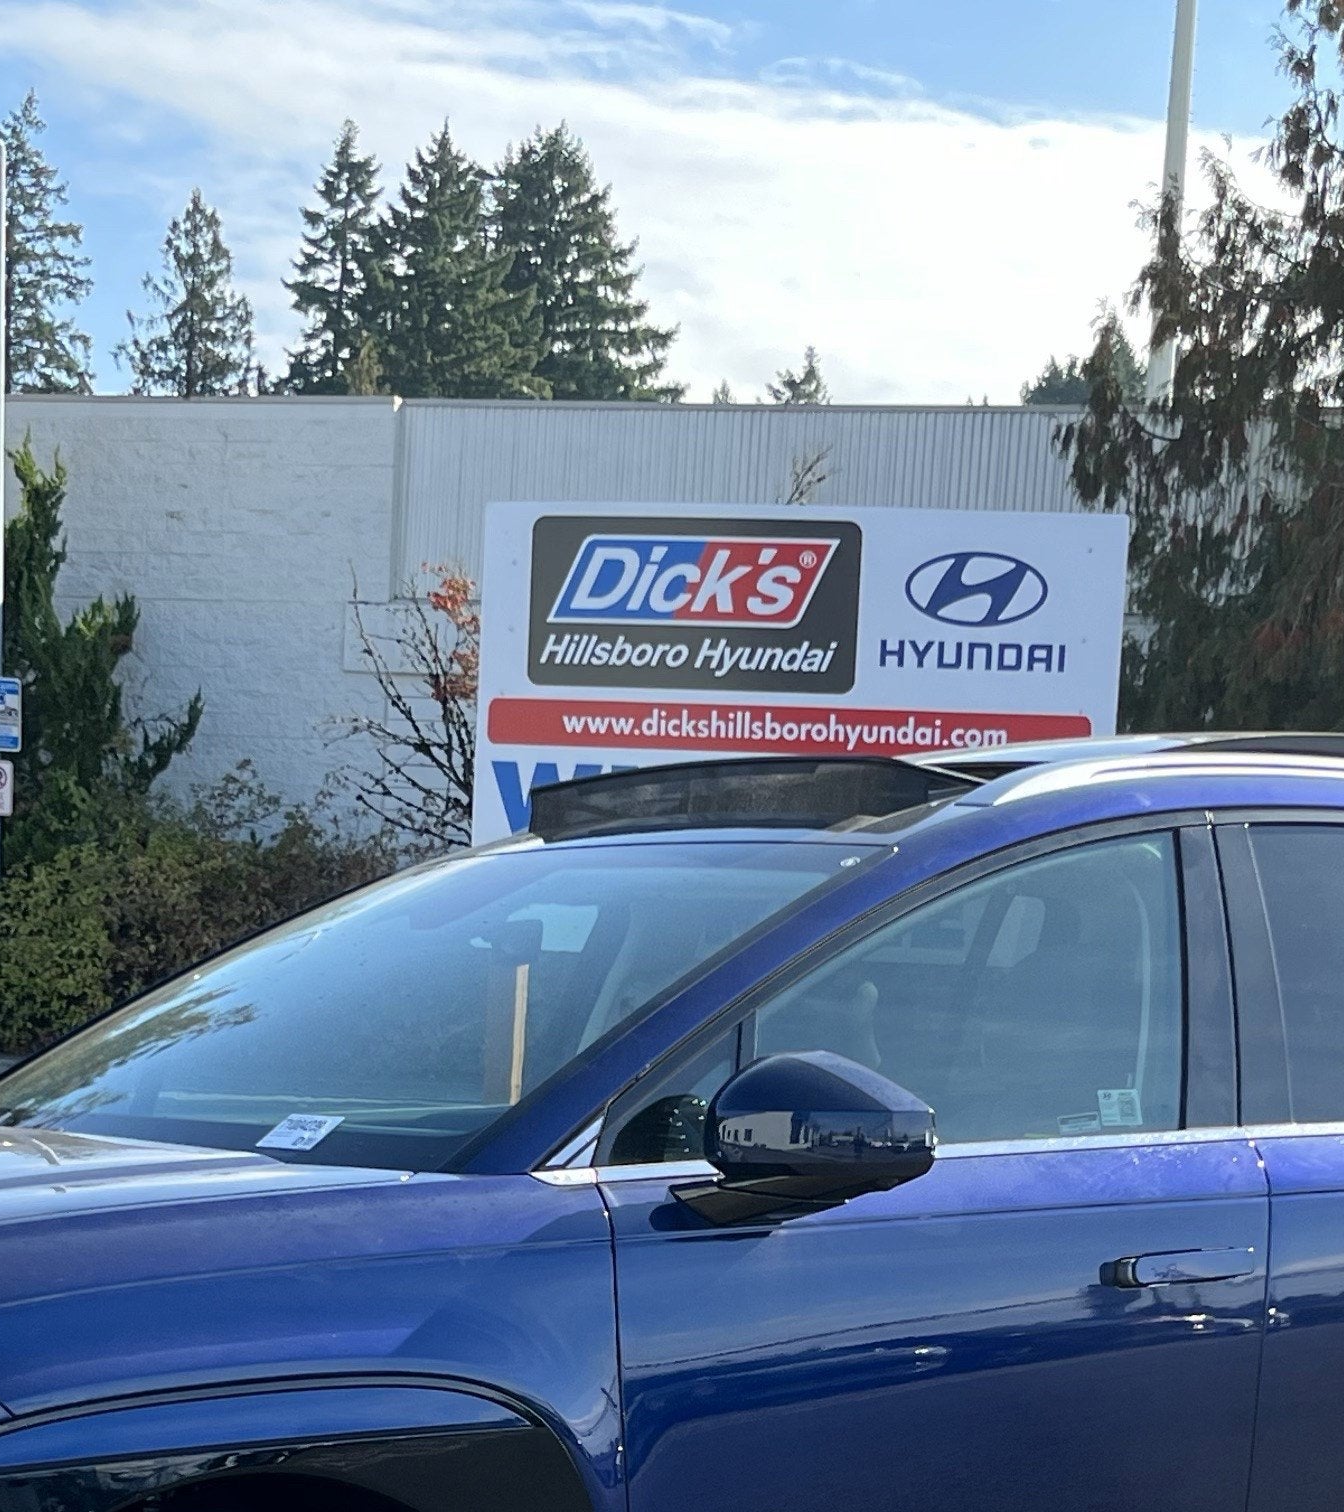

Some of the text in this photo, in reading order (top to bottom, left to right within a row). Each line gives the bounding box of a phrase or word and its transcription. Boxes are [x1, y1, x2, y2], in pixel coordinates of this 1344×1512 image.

[570, 545, 802, 616] Dick's
[539, 634, 838, 678] Hillsboro Hyundai
[879, 639, 1066, 673] HYUNDAI
[562, 708, 1009, 751] www.dickshillsborohyundai.com
